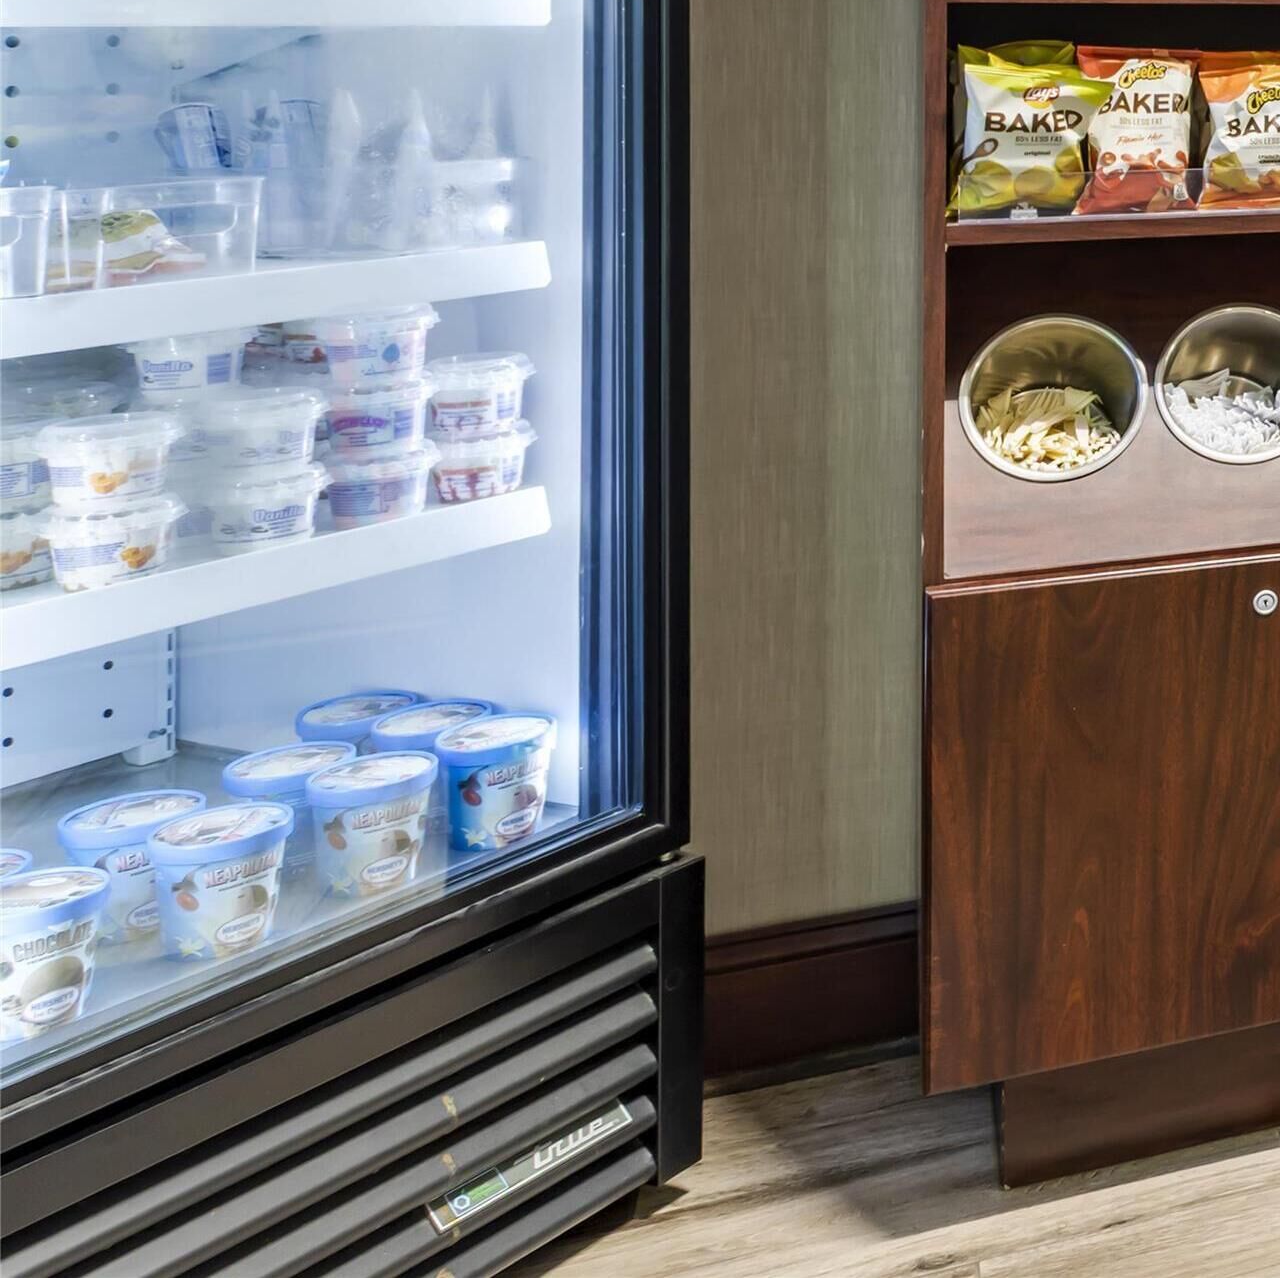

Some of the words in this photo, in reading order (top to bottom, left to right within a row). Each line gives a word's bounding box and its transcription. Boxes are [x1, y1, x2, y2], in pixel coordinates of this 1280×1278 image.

[1119, 63, 1166, 89] Cheetos
[1098, 93, 1190, 116] BAKED
[984, 109, 1085, 134] BAKED
[1030, 134, 1047, 144] LESS
[1048, 135, 1063, 144] FAT
[1263, 137, 1279, 146] LESS
[1024, 150, 1052, 158] original
[142, 359, 193, 372] Vanilla
[254, 504, 305, 522] Vanilla
[205, 850, 279, 889] NEAPOLITAN
[12, 919, 95, 963] CHOCOLATE
